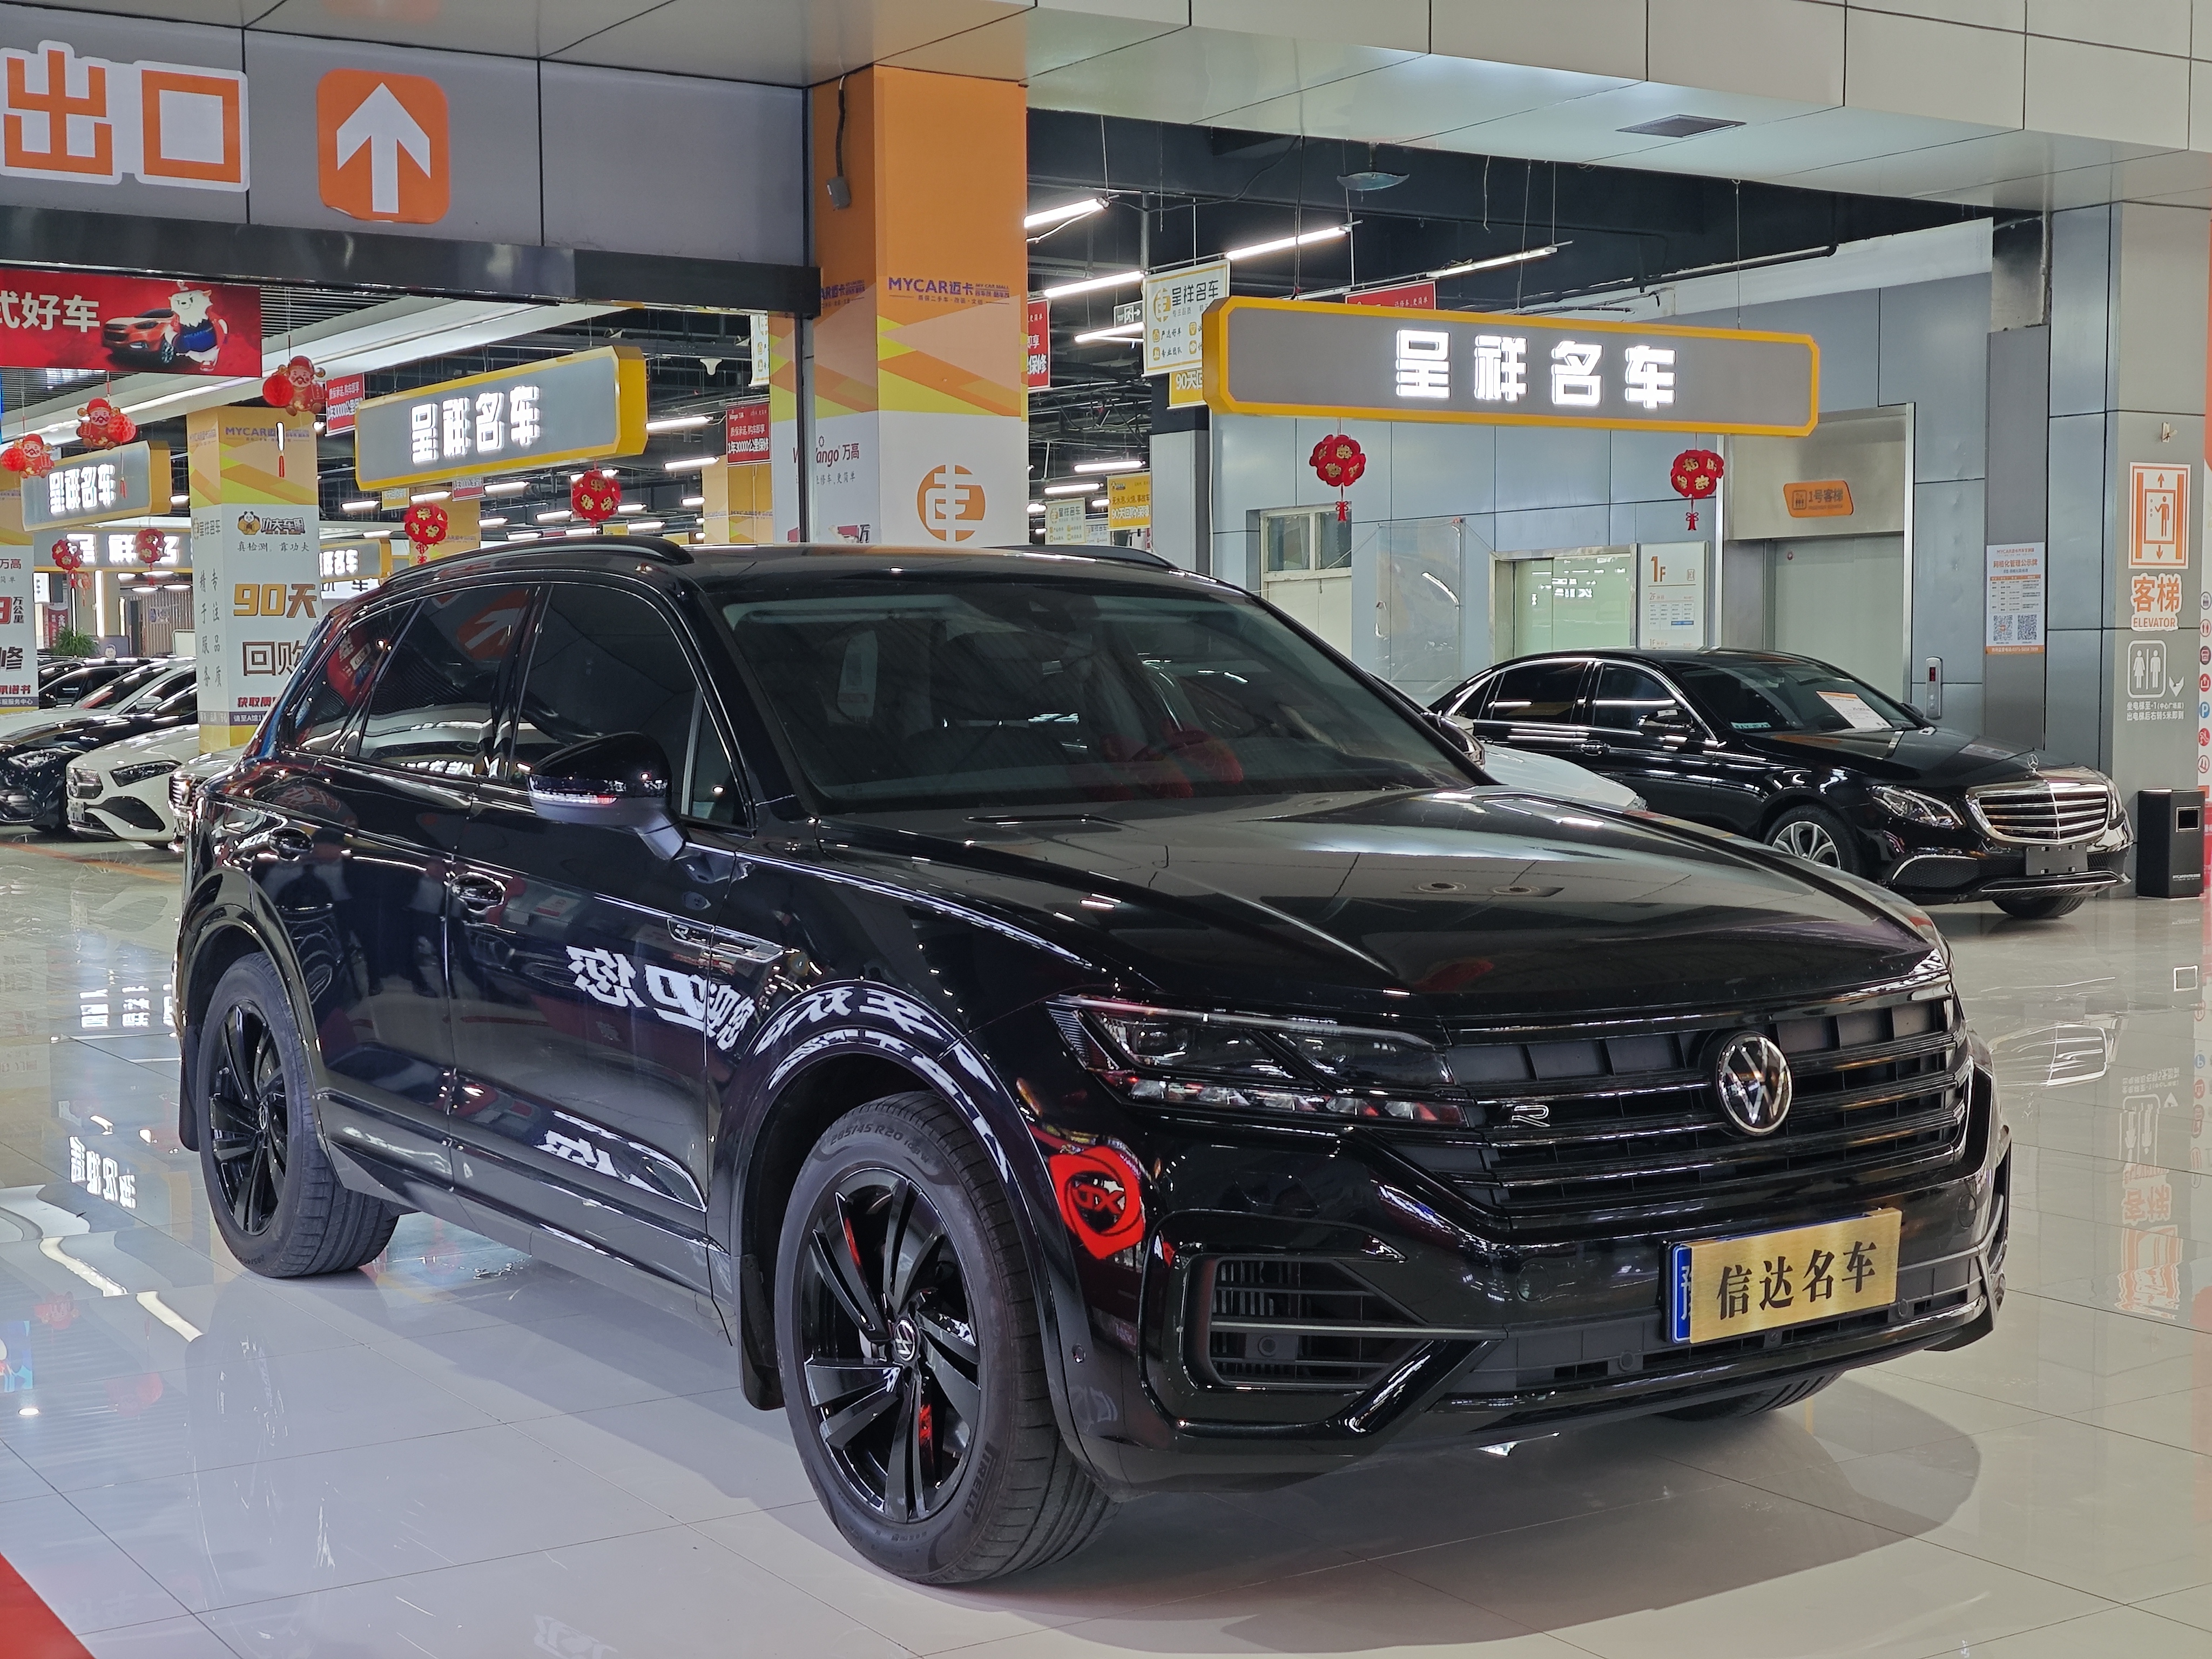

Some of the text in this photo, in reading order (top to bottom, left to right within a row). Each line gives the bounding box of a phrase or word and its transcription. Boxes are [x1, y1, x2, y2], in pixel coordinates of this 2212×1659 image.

[3, 48, 243, 185] 出口
[888, 276, 974, 295] MYCAR迈卡
[1172, 280, 1219, 306] 呈祥名车
[1027, 354, 1047, 375] 保修
[1396, 329, 1676, 409] 呈祥名车
[225, 427, 276, 437] MYCAR迈
[410, 385, 540, 463] 呈祥名车
[816, 448, 839, 467] ango
[842, 443, 859, 461] 万高
[49, 464, 116, 514] 呈祥名车
[1809, 488, 1843, 503] 1号客梯
[1112, 504, 1149, 519] 90天回购保障
[0, 558, 21, 569] 万高
[319, 549, 359, 578] 祥名车
[1651, 556, 1666, 582] 1F
[233, 583, 317, 618] 90天
[2133, 576, 2180, 613] 客梯
[13, 596, 24, 624] 万公里
[2133, 617, 2176, 628] ELEVATOR
[2127, 711, 2184, 721] 出电梯后右转5米即到
[875, 1124, 904, 1141] R20
[1717, 1241, 1877, 1320] 信达名车
